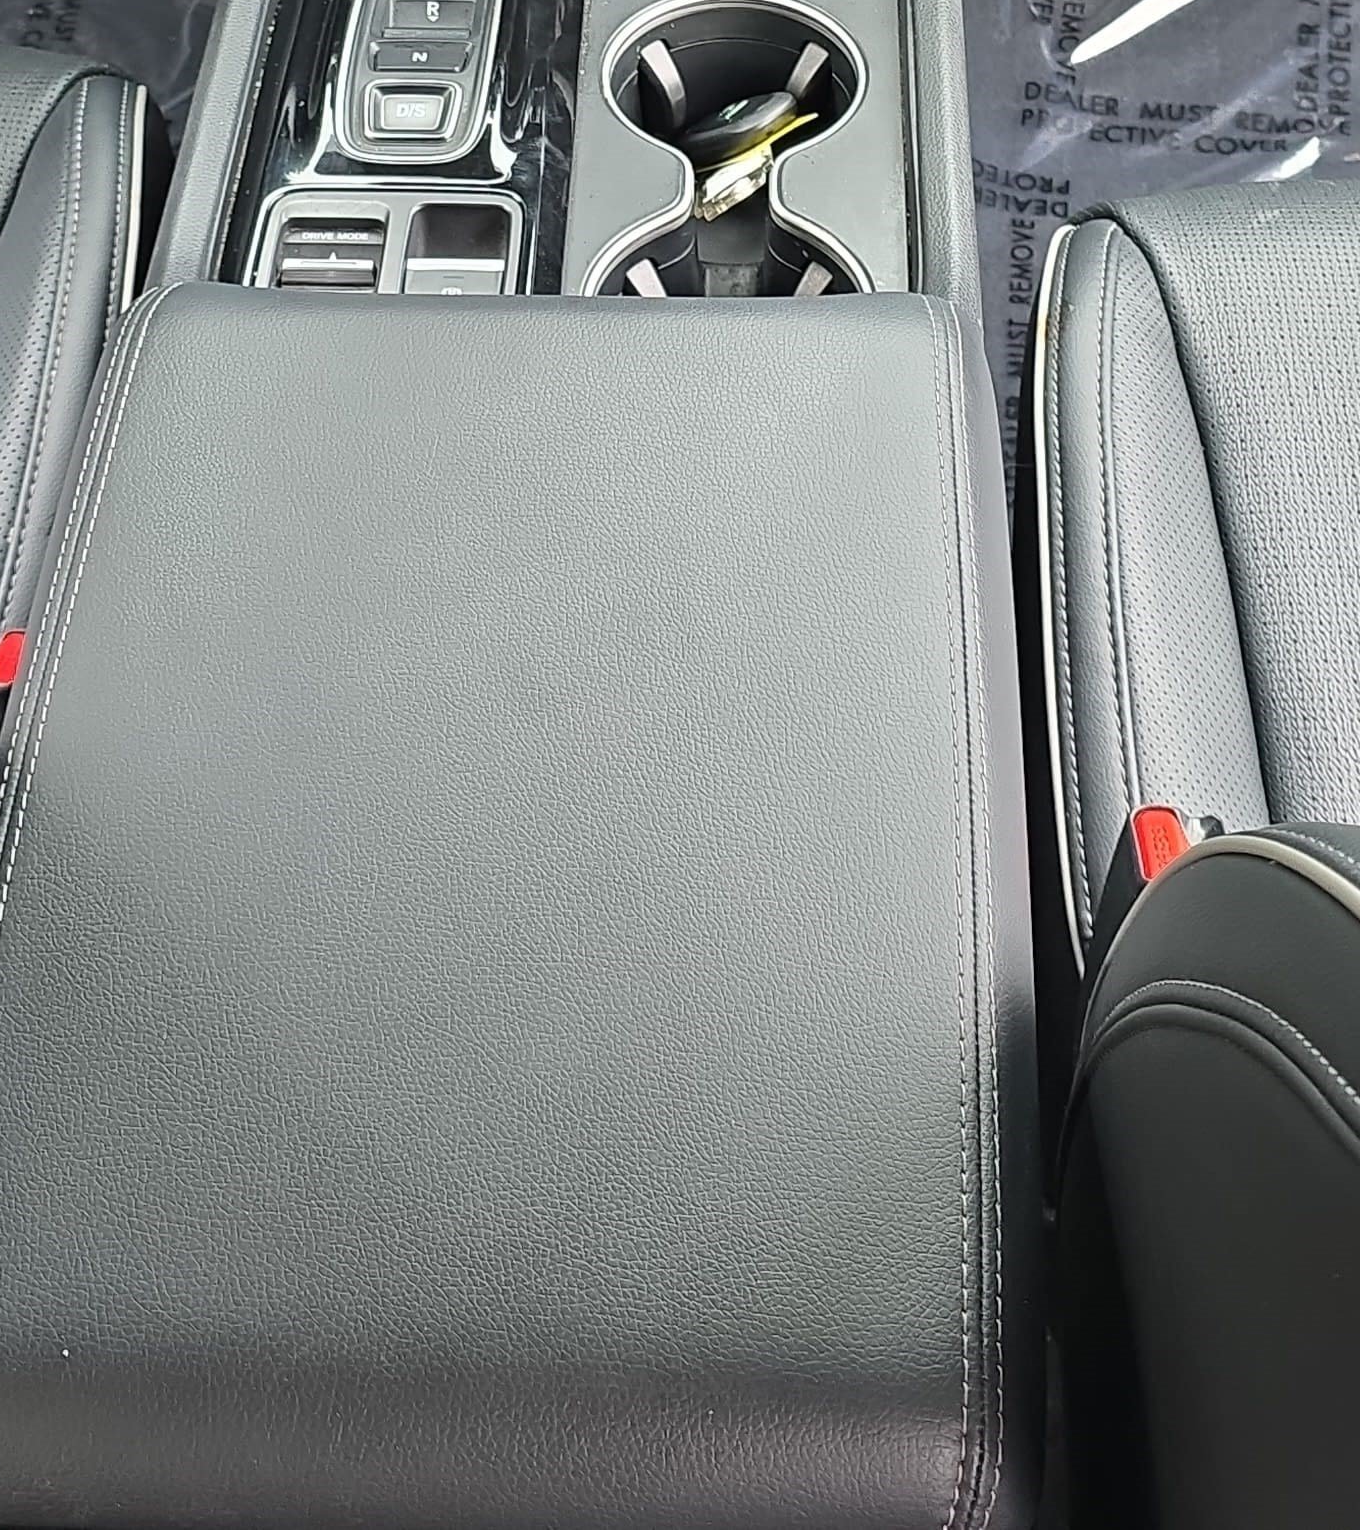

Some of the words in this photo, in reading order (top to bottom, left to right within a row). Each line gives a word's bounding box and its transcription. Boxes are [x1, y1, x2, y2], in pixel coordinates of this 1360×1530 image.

[427, 1, 439, 16] R
[412, 52, 427, 62] N
[1293, 22, 1321, 113] DEALER
[396, 103, 426, 118] D/S
[1024, 81, 1119, 116] DEALER
[1140, 103, 1217, 124] MUST
[1234, 111, 1351, 136] REMOVE
[1021, 109, 1180, 150] PECTIVE
[1194, 134, 1288, 154] COVER
[302, 232, 334, 241] DRIVE
[337, 232, 369, 241] MODE
[1008, 218, 1035, 306] REMOVE
